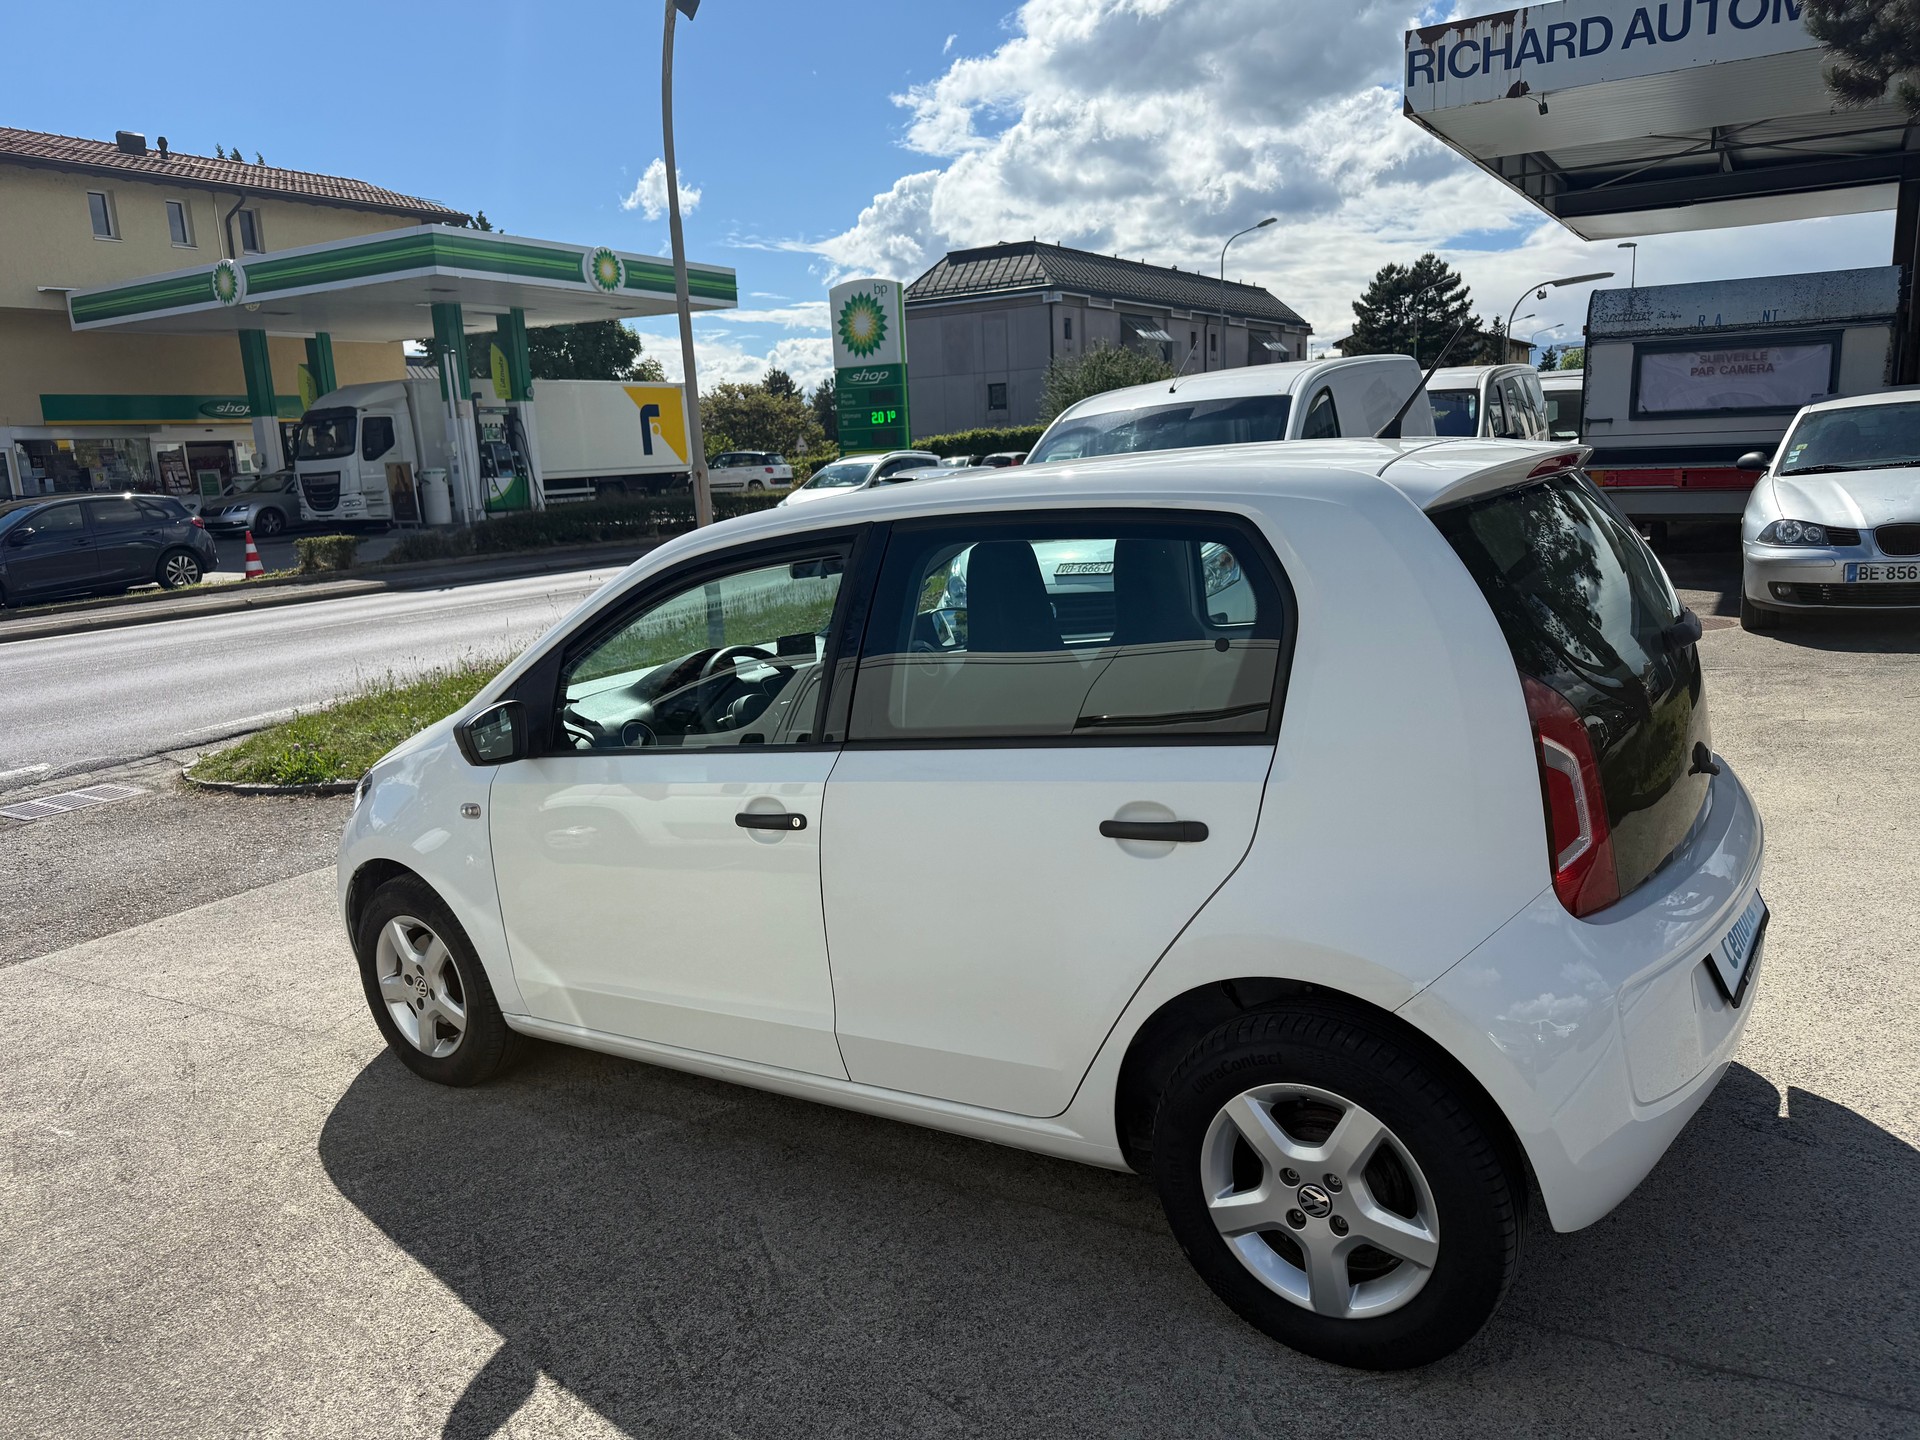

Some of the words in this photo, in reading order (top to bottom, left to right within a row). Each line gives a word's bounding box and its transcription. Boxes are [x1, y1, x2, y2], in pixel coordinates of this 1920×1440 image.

[1406, 15, 1614, 88] RICHARD
[873, 283, 888, 297] bp
[1699, 350, 1768, 364] SURVEILLE
[852, 369, 889, 384] shop
[1690, 366, 1716, 377] PAR
[1719, 362, 1775, 375] CAMERA
